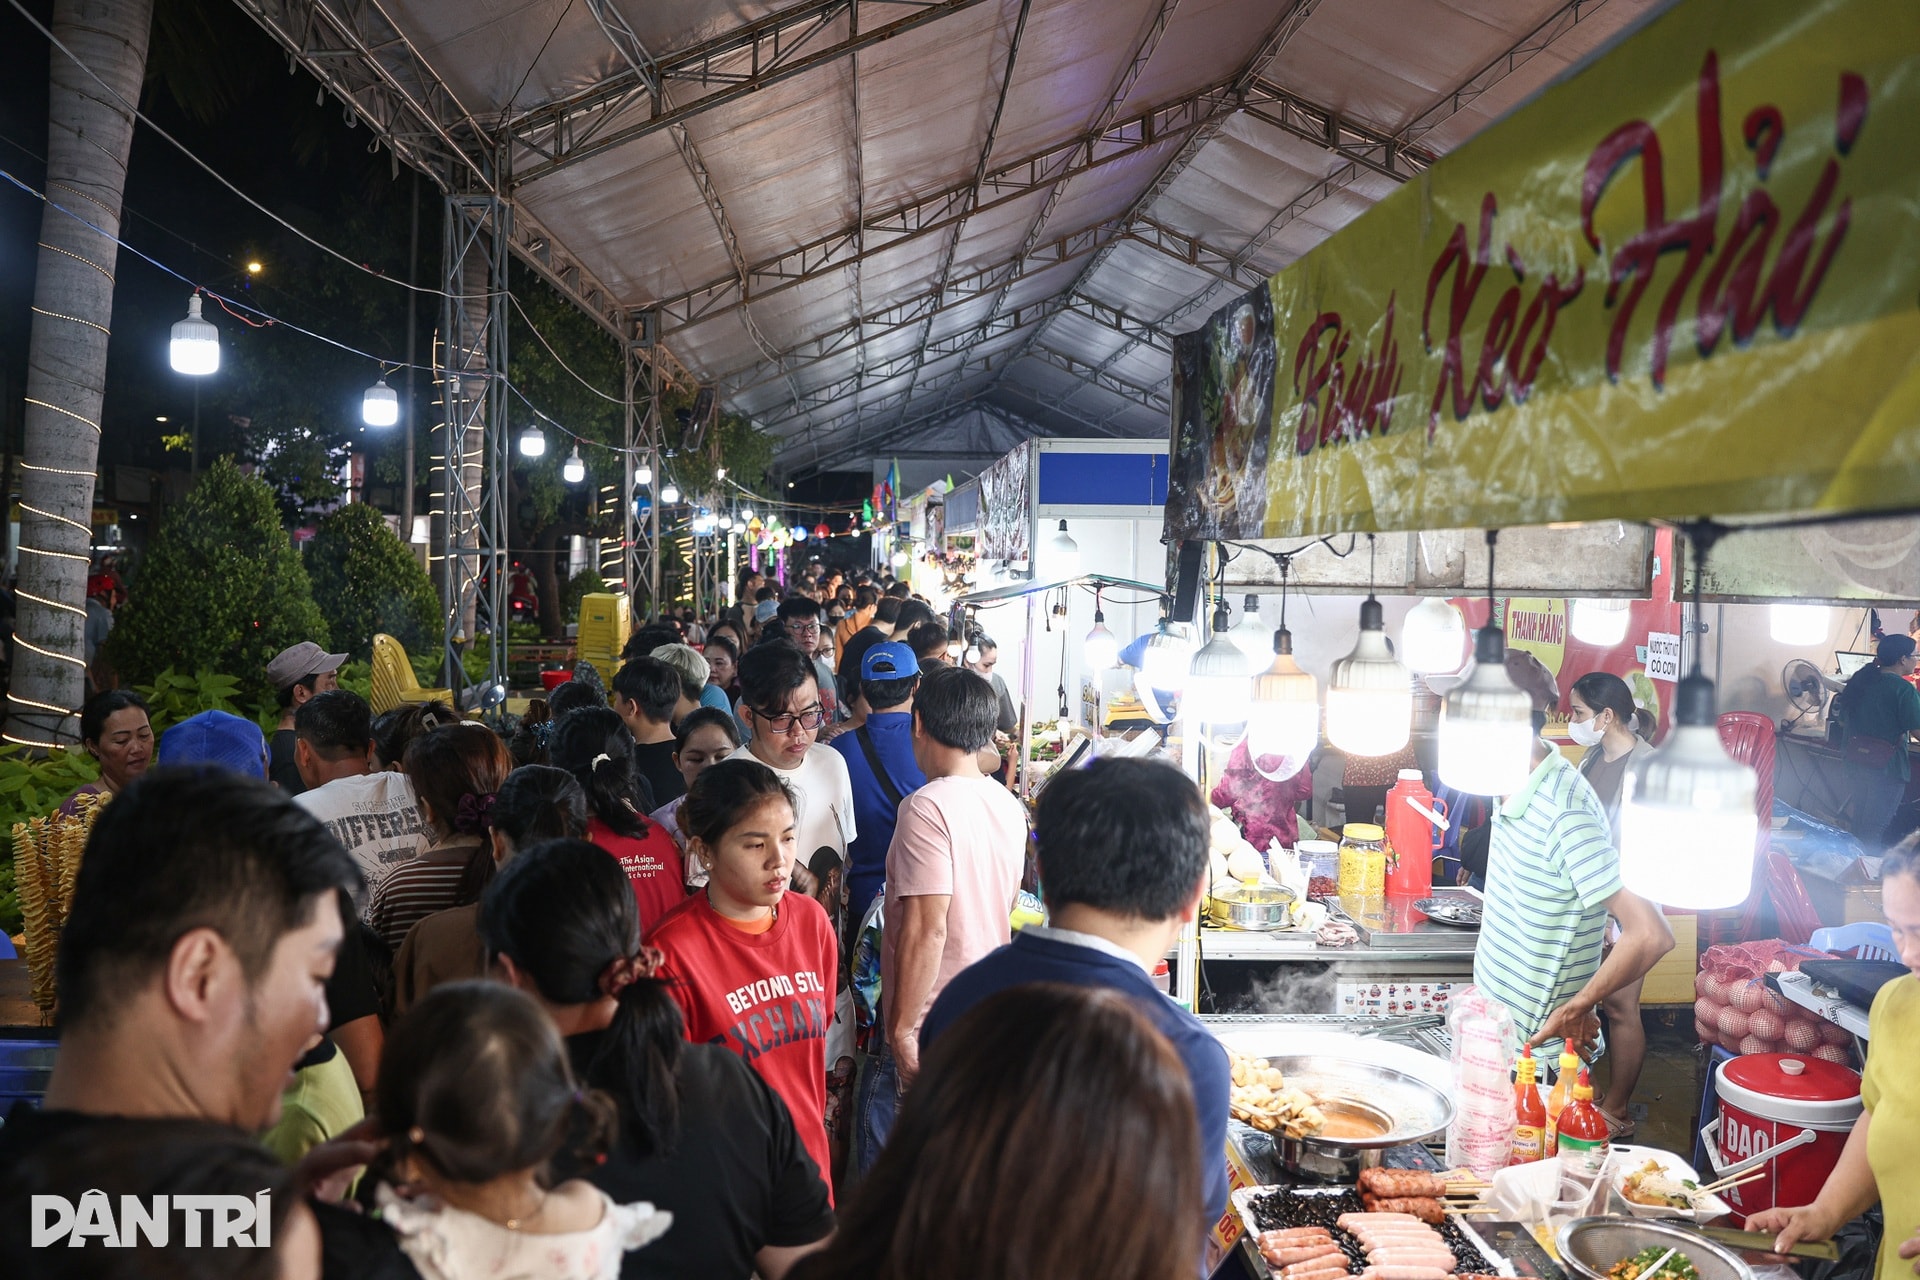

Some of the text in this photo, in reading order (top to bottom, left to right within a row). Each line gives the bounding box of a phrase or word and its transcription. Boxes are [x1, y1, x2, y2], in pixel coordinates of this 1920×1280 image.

[1423, 191, 1585, 447] Xèo
[1580, 48, 1870, 393] Hải
[1512, 610, 1537, 641] THANH
[1651, 656, 1662, 673] CÓ
[619, 854, 655, 865] The Asian
[622, 862, 664, 873] International
[627, 870, 656, 880] School
[725, 974, 795, 1015] BEYOND
[1726, 1116, 1769, 1164] ĐAO
